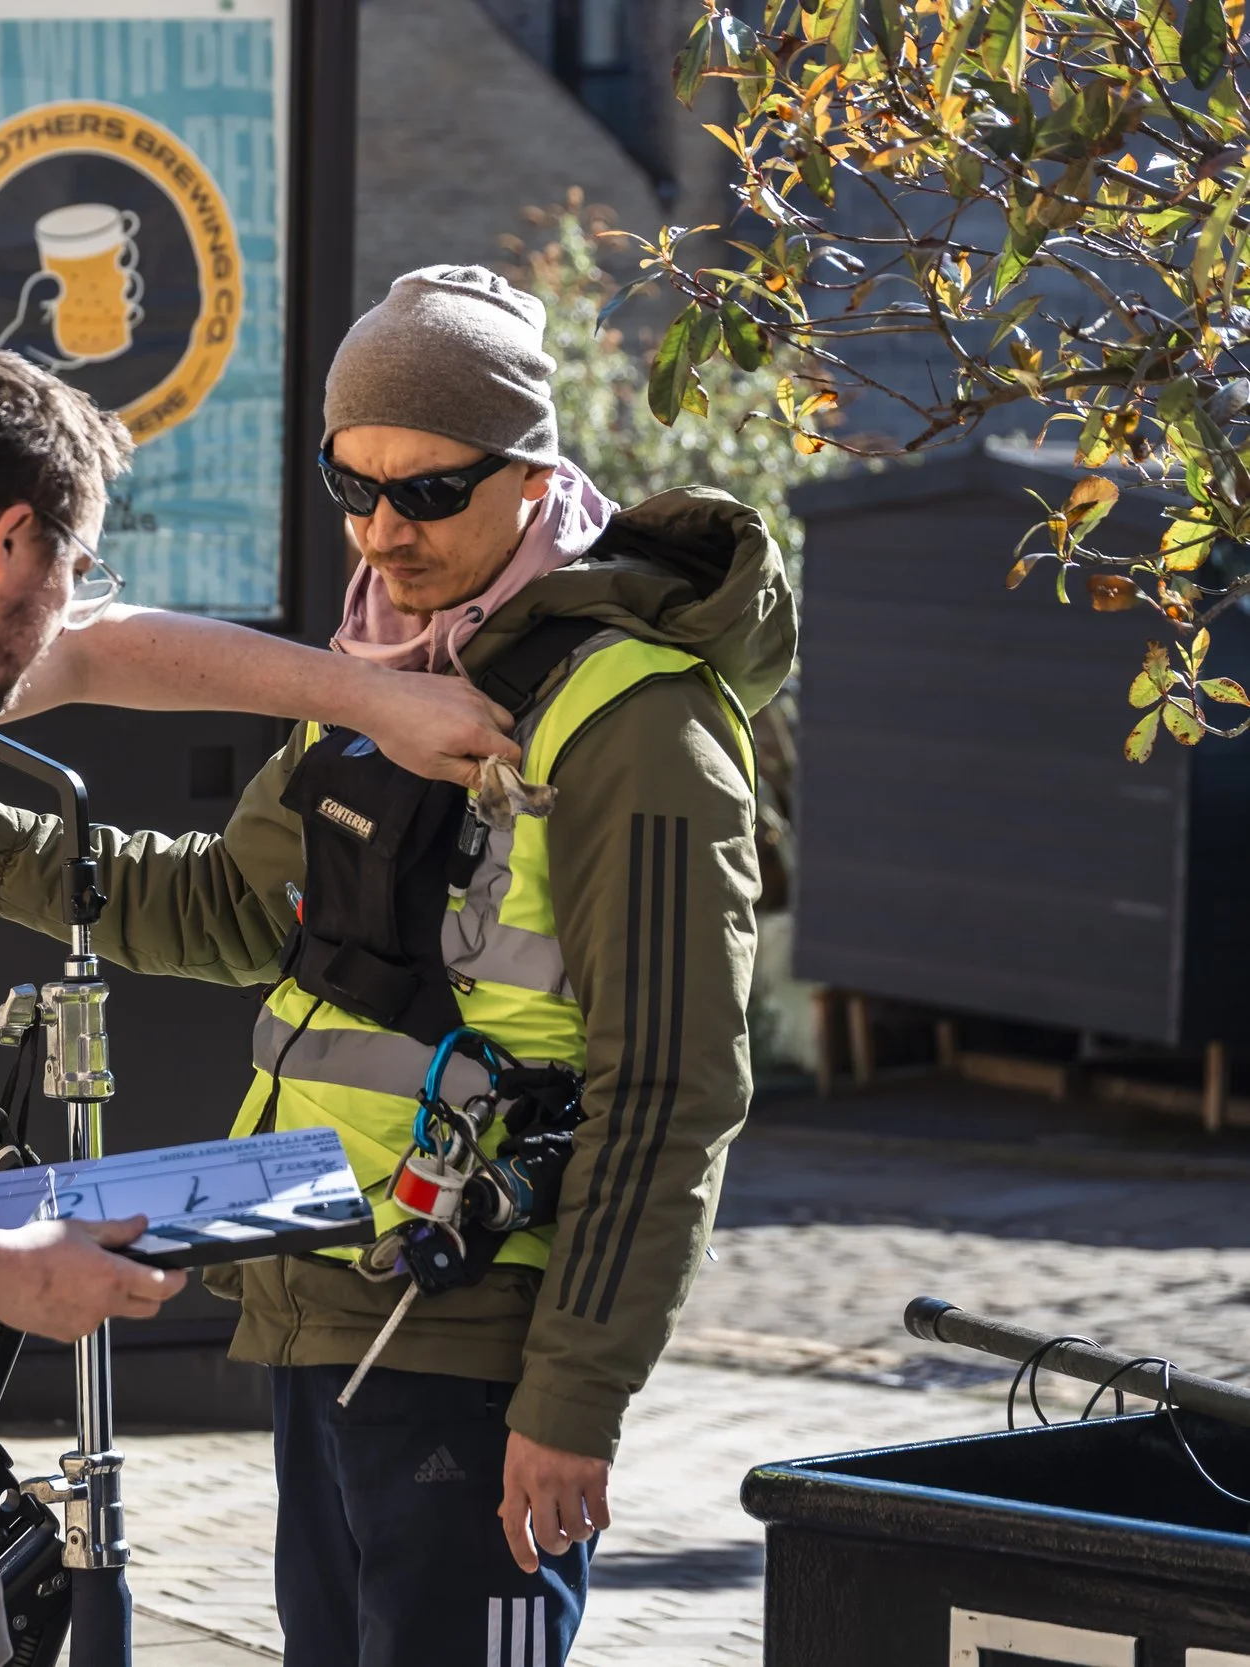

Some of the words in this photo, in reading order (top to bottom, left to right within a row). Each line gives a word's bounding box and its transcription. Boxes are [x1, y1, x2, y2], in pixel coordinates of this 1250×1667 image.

[132, 130, 232, 281] BREWING
[321, 798, 372, 834] CONTERRA
[414, 1469, 466, 1484] adidas
